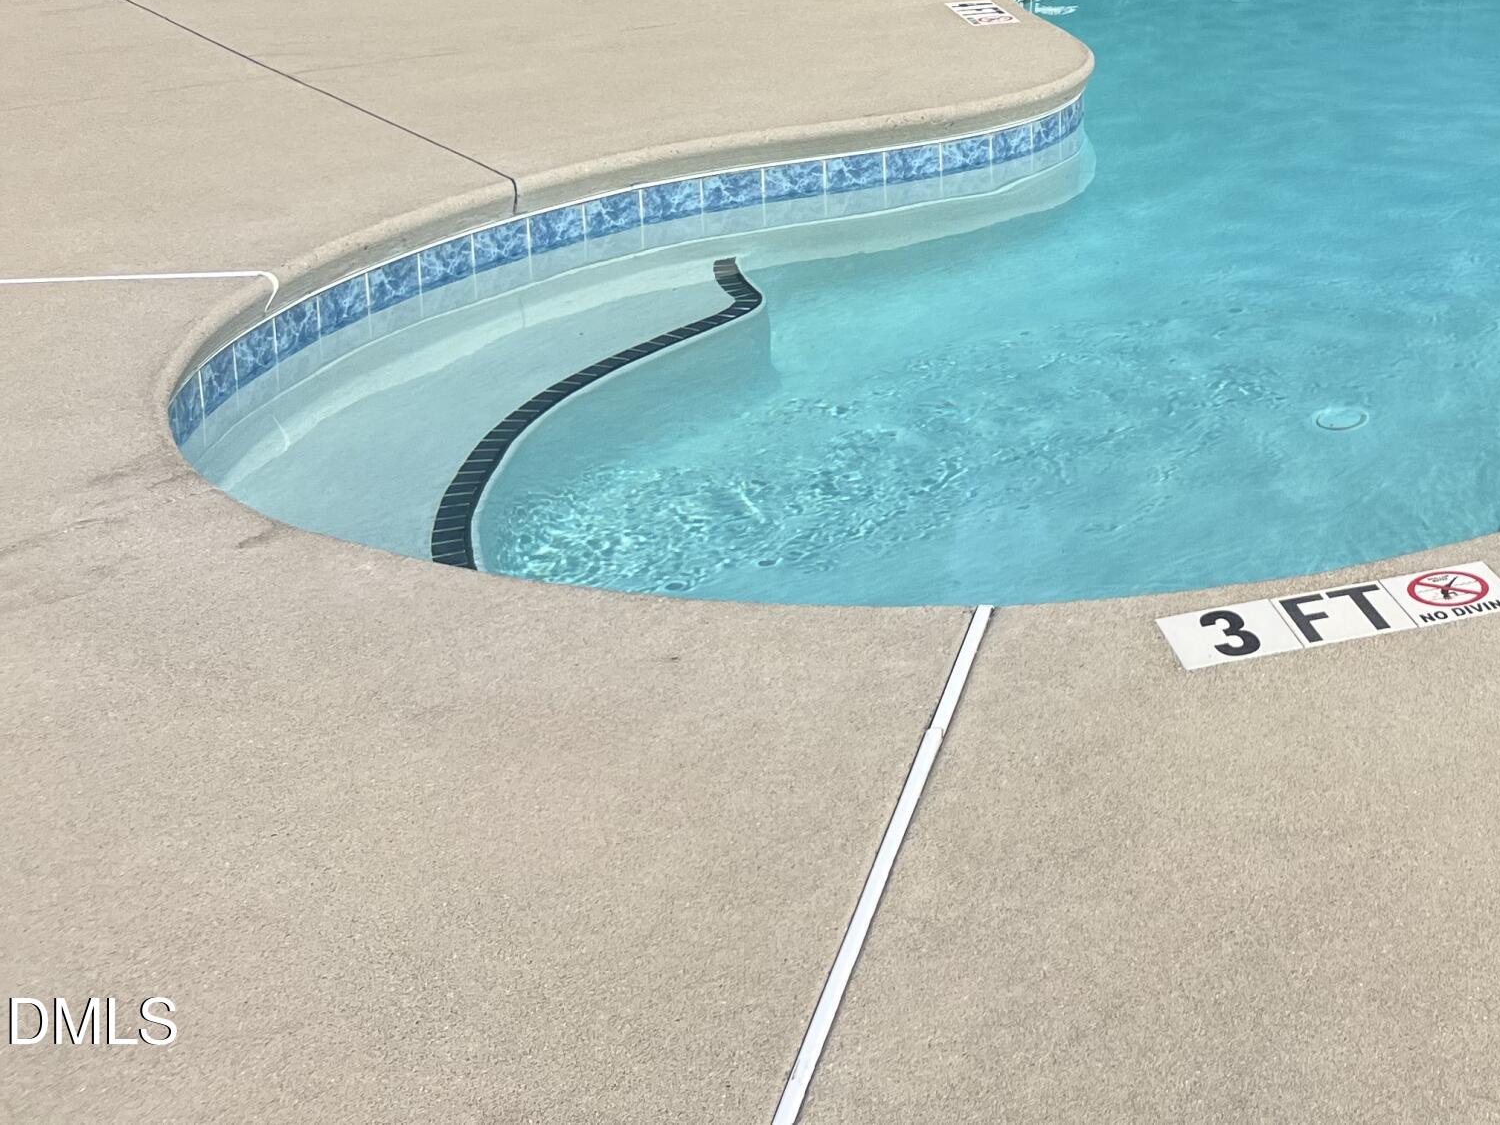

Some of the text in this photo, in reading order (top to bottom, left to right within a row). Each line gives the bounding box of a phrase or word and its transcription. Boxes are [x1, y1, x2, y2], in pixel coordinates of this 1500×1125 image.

[1199, 584, 1392, 656] 3 FT
[1419, 610, 1448, 623] NO
